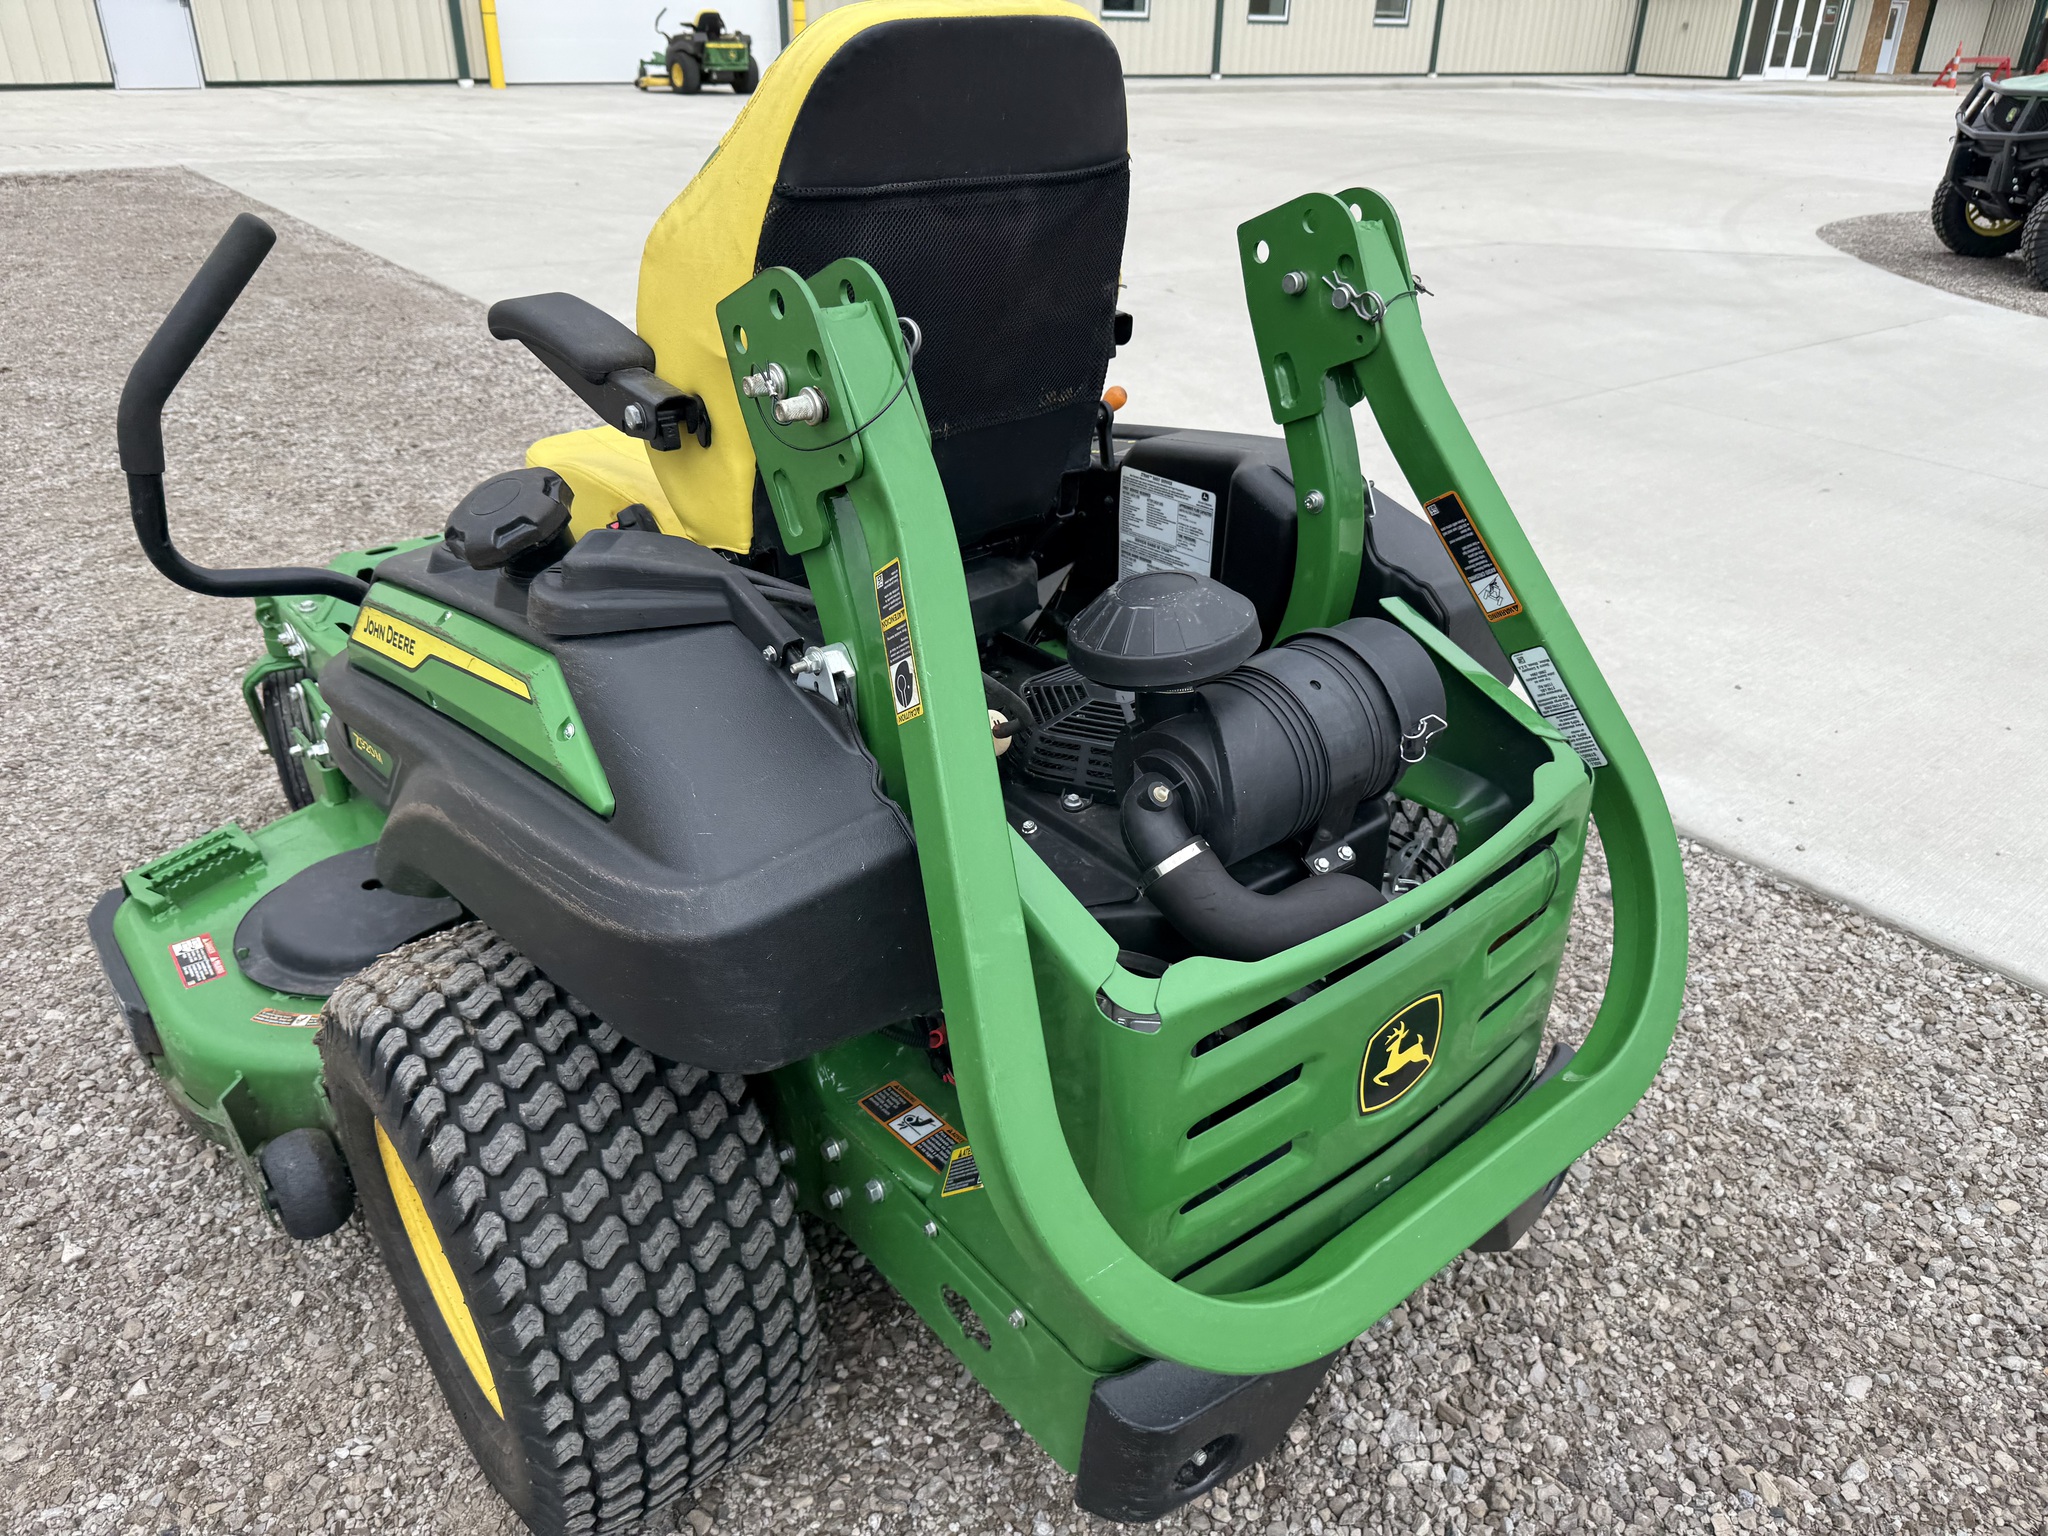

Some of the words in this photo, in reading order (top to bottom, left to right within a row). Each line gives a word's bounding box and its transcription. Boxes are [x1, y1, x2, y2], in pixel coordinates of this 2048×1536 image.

[1488, 608, 1514, 620] WARNING
[363, 615, 386, 643] JOHN
[387, 626, 416, 656] DEERE
[898, 708, 917, 723] CAUTION
